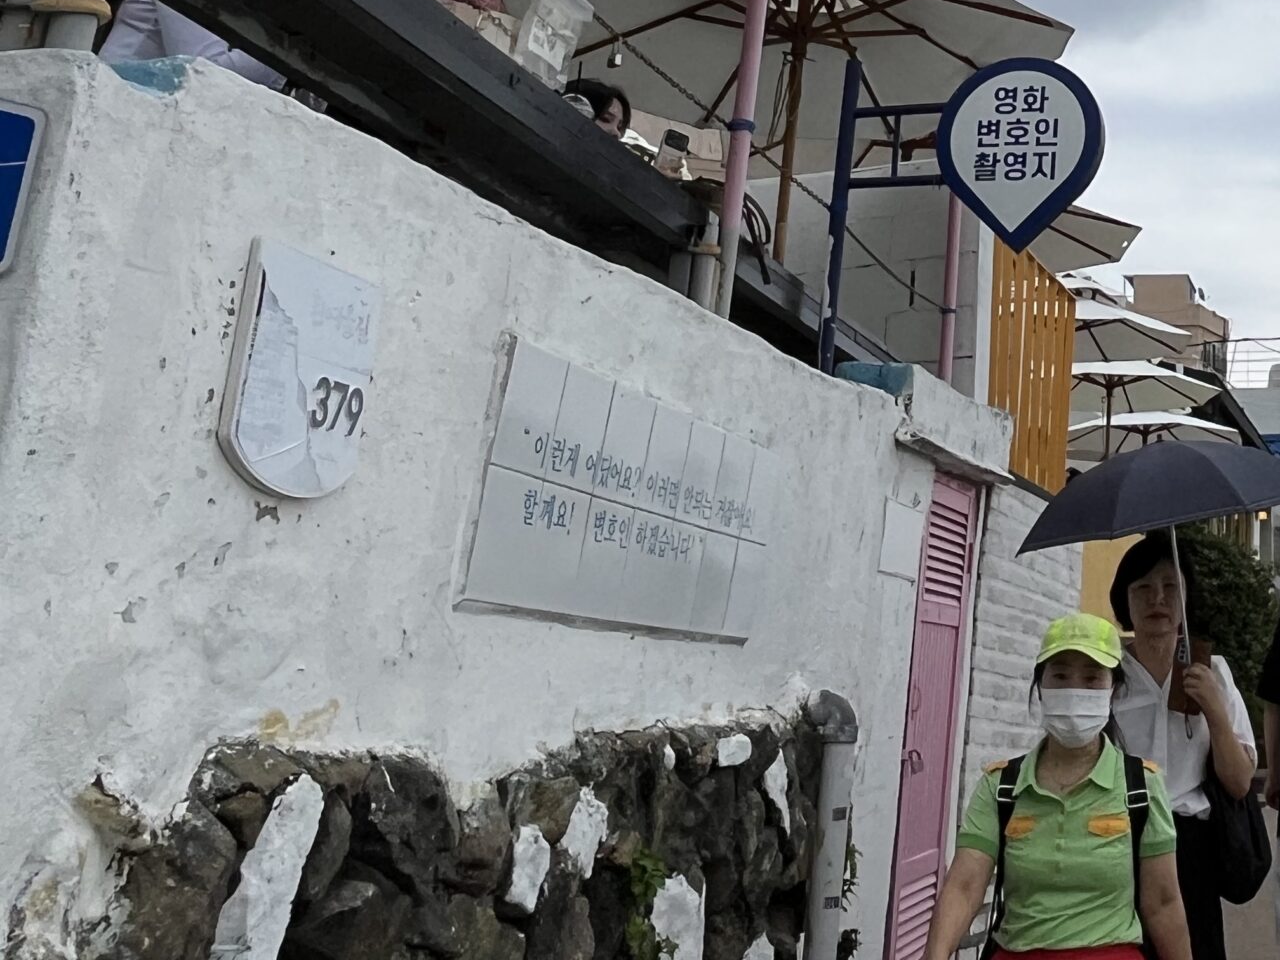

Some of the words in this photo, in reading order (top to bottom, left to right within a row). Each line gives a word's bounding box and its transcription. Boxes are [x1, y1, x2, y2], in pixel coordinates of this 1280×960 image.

[993, 86, 1049, 115] 영화
[977, 117, 1059, 148] 변호인
[974, 151, 1057, 181] 촬영지
[309, 376, 364, 437] 379
[594, 510, 632, 549] 변호인
